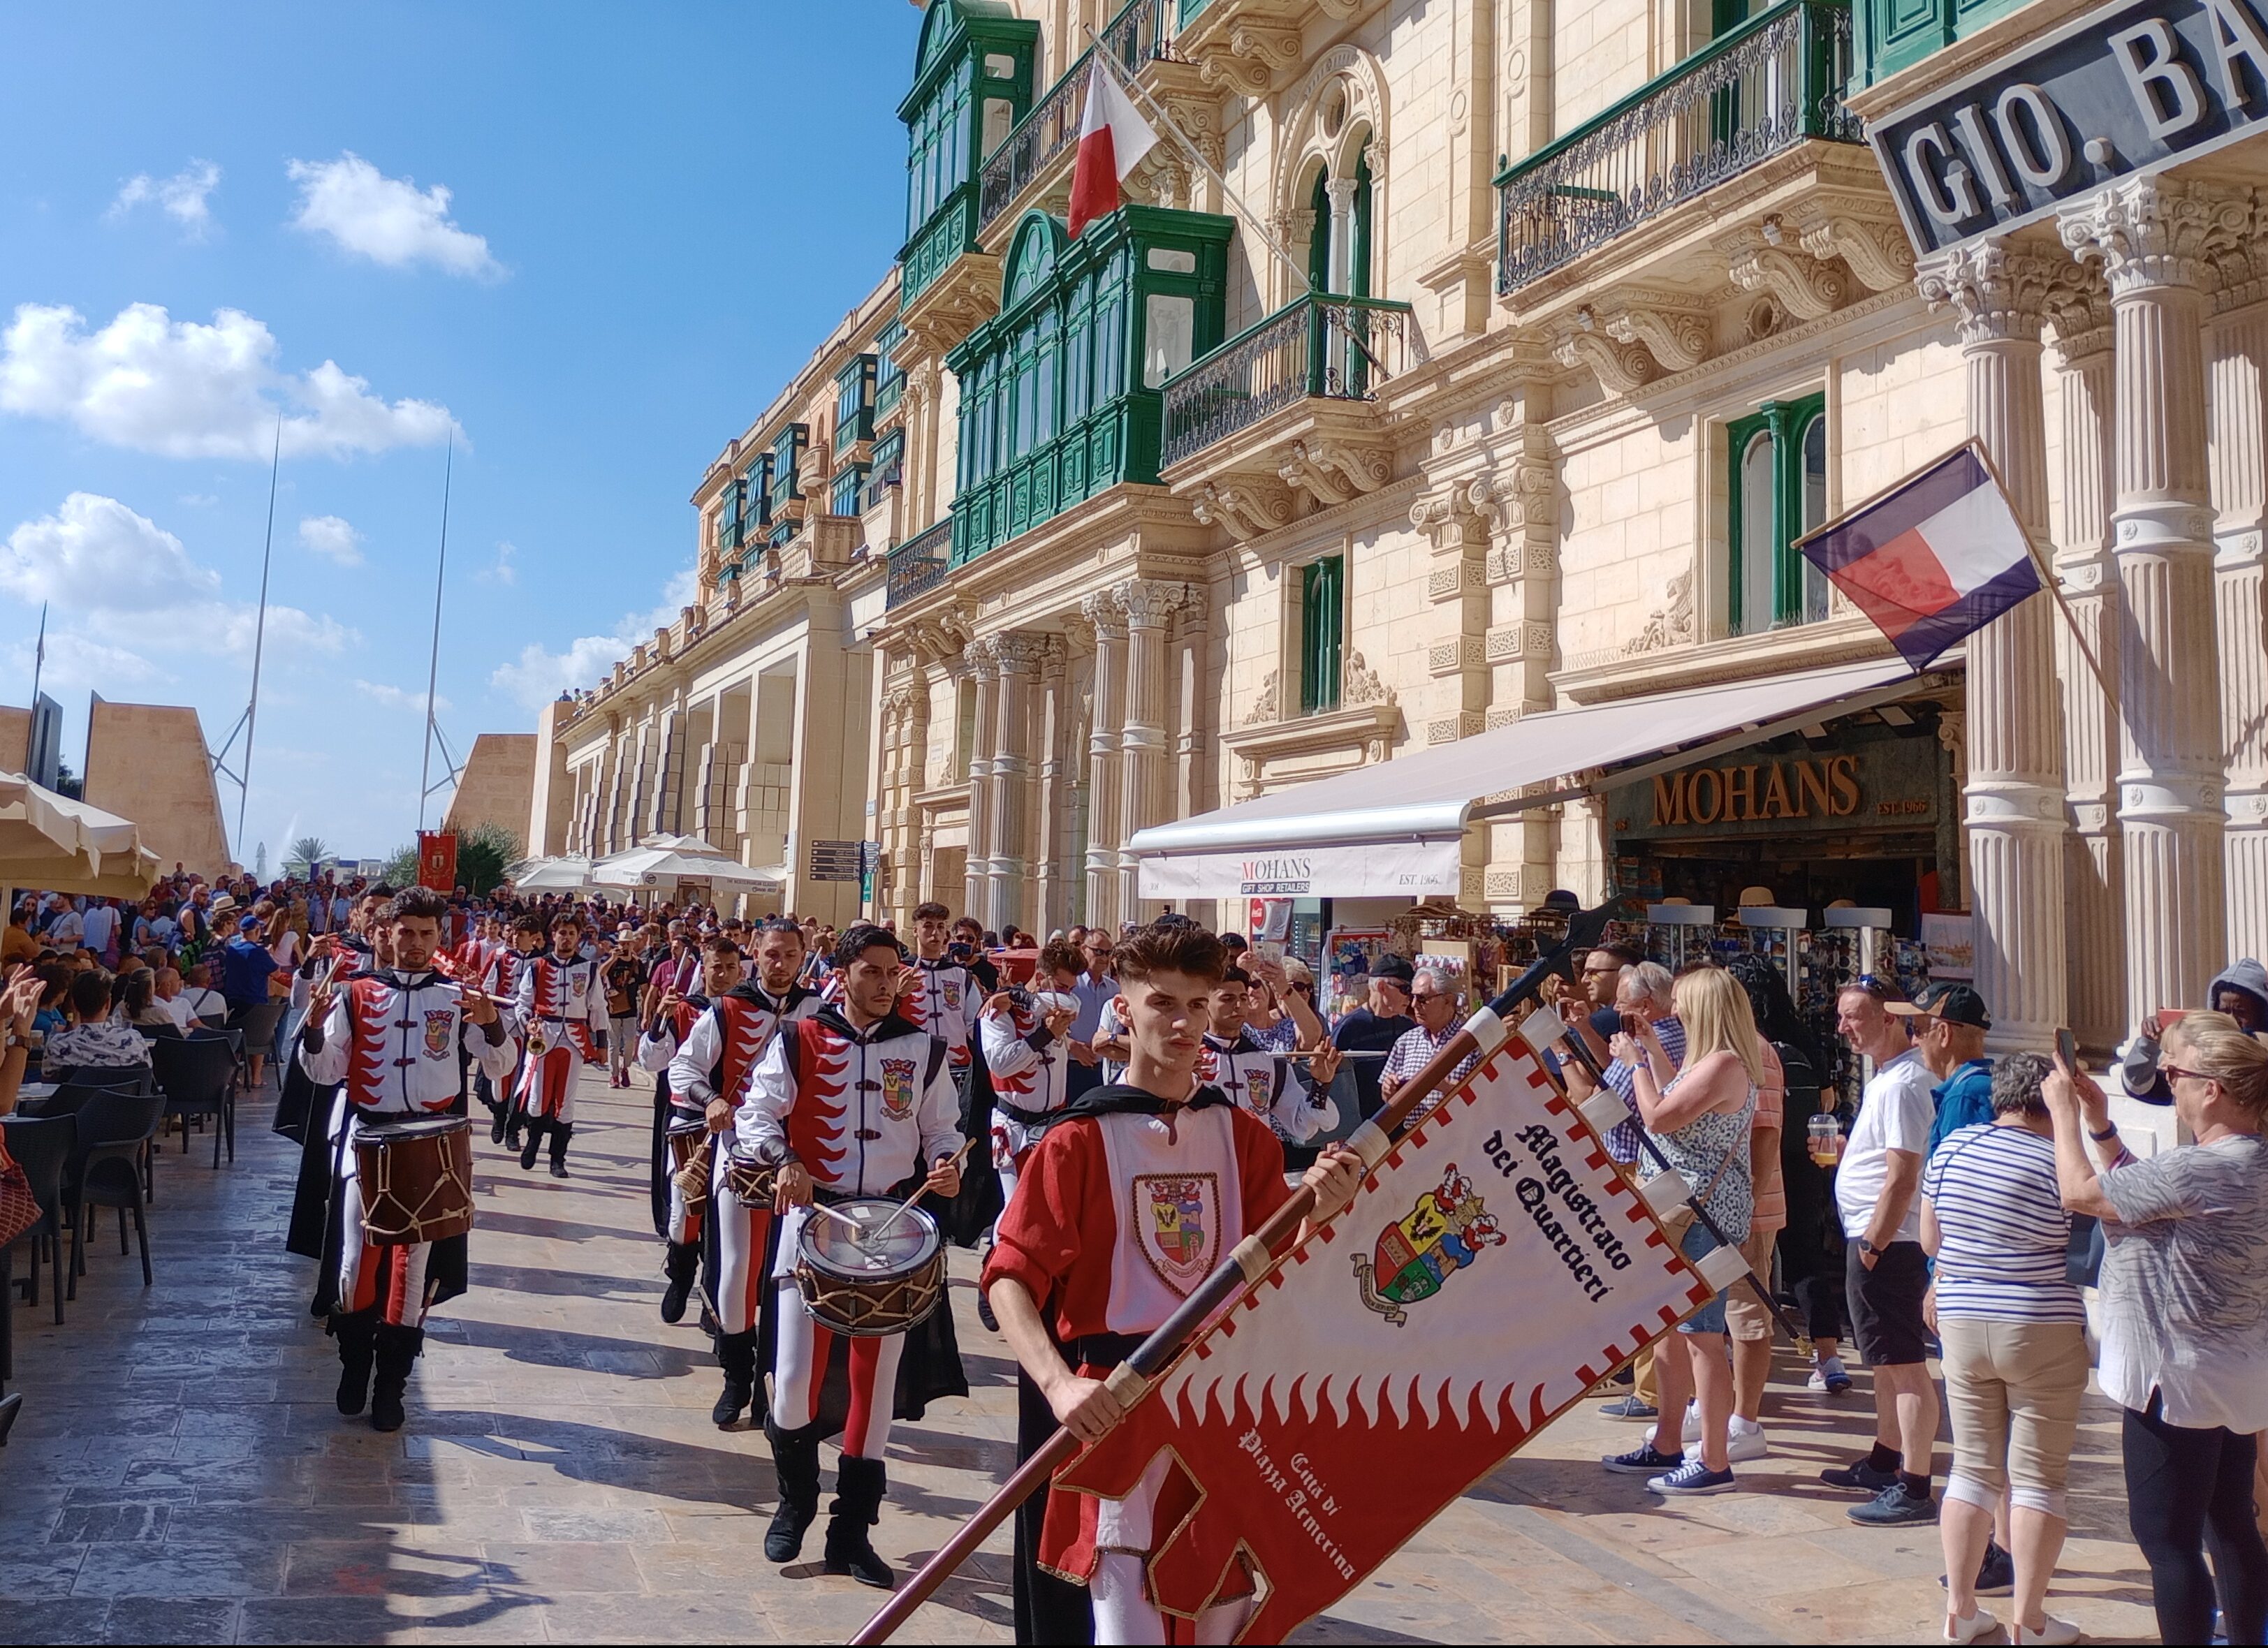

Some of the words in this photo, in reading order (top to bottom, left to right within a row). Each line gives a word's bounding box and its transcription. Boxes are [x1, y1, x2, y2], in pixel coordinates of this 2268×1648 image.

[1648, 755, 1861, 827] MOHANS
[1902, 800, 1927, 813] 1966
[1242, 858, 1311, 881] MOHANS
[1242, 883, 1255, 893] GIFT
[1275, 882, 1310, 892] RETAILERS
[1399, 874, 1417, 885] EST.
[1420, 874, 1439, 885] 1966
[1482, 1129, 1523, 1178] dei
[1515, 1177, 1614, 1303] Quartieri
[1514, 1124, 1632, 1270] Magistrato
[1238, 1427, 1288, 1493] Piazza
[1285, 1489, 1356, 1580] Armerina
[1291, 1452, 1327, 1499] Città
[1322, 1495, 1342, 1516] di
